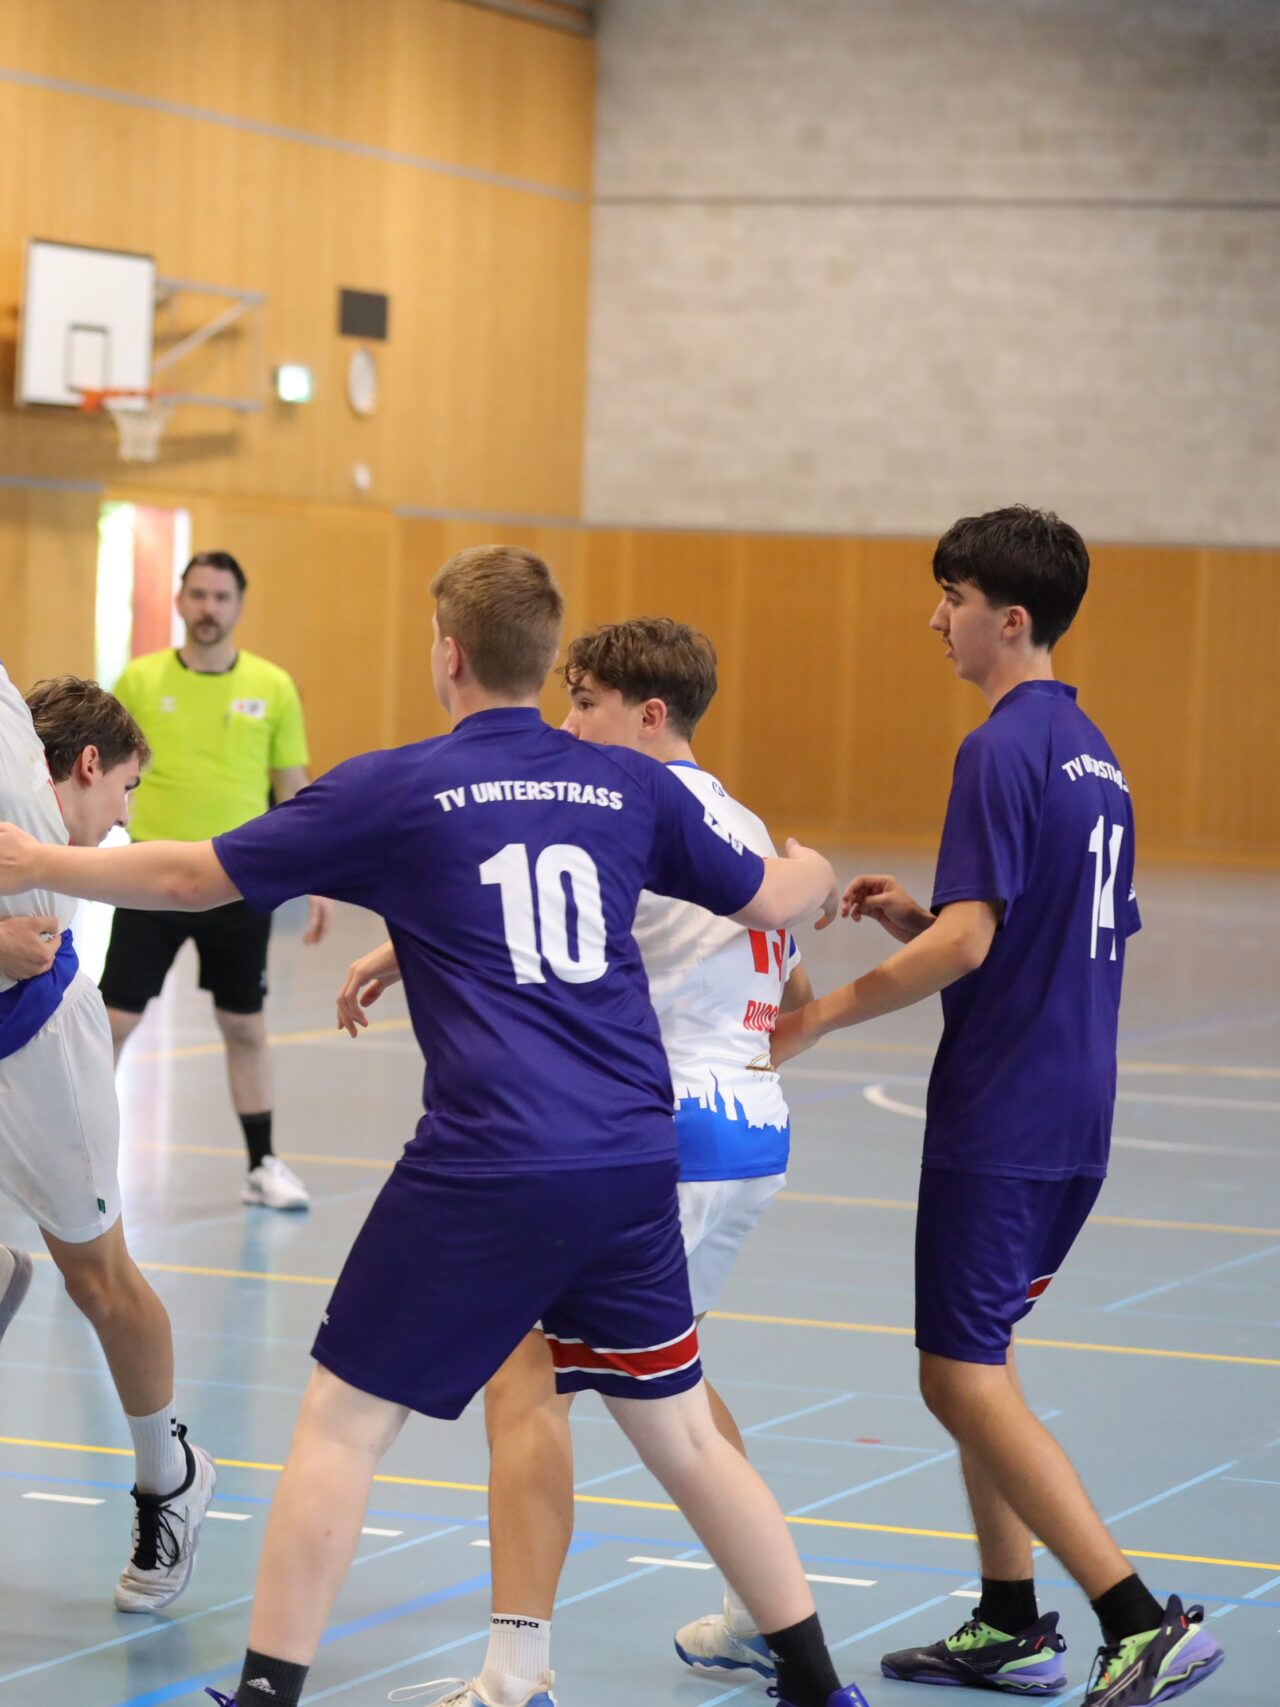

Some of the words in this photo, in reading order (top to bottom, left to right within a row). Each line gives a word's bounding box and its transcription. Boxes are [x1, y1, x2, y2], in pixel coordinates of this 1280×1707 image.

[1061, 757, 1084, 781] TV
[434, 785, 466, 813] TV
[470, 780, 624, 811] UNTERSTRASS
[478, 843, 609, 985] 10
